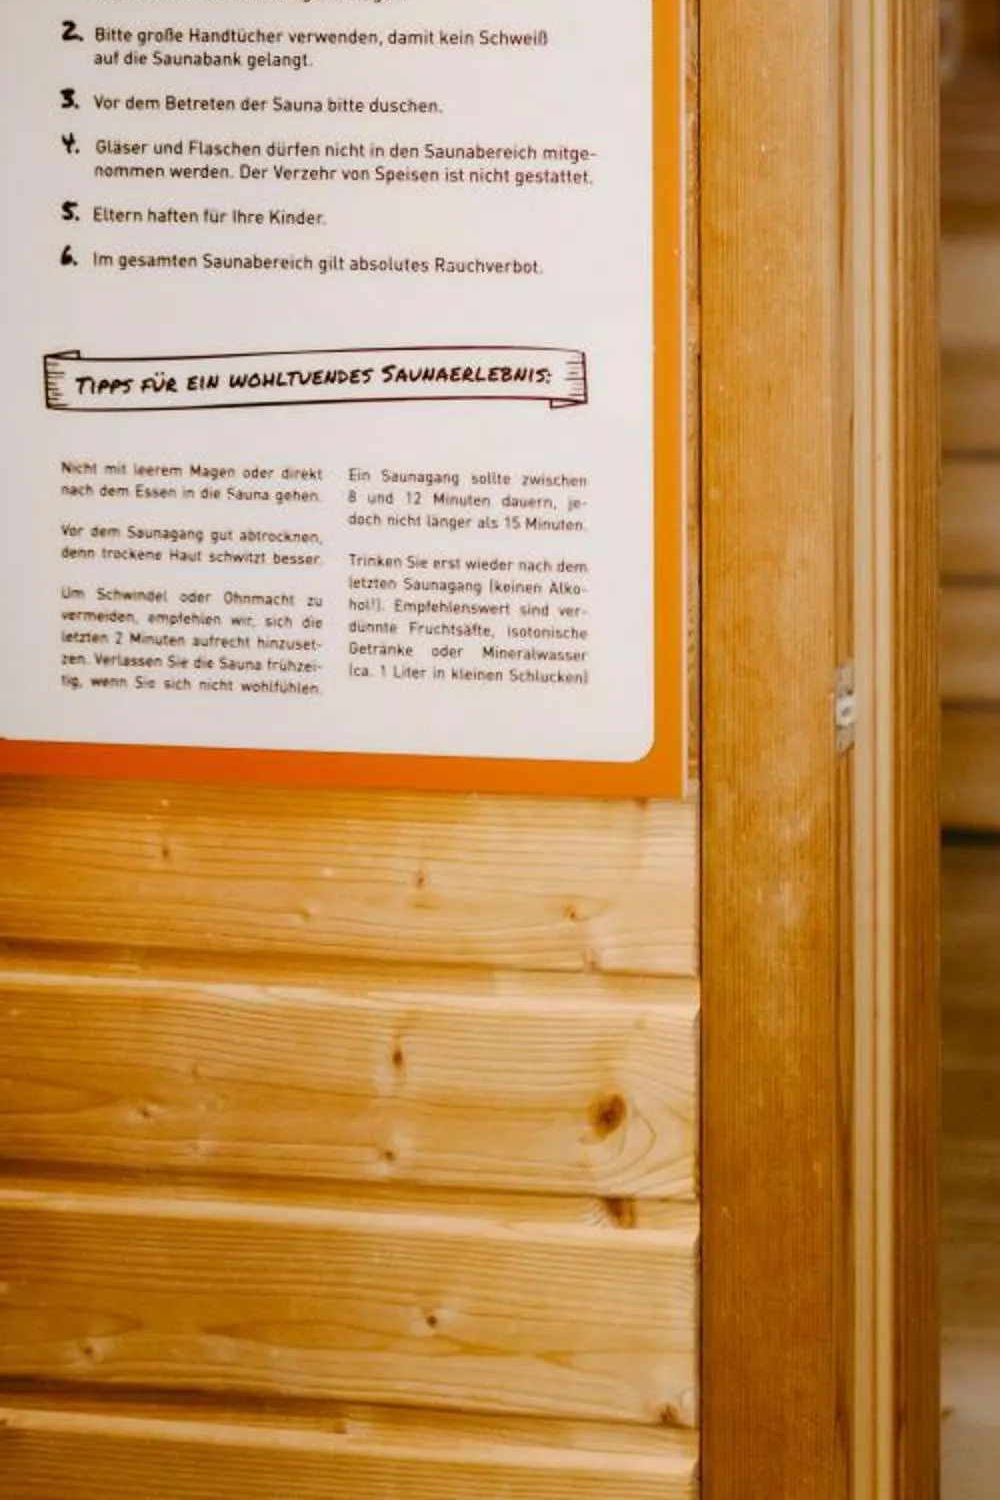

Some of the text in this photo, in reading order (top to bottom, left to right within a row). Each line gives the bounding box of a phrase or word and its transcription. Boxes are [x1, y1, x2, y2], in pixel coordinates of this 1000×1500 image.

[62, 19, 84, 41] 2.
[95, 27, 133, 43] Bitte
[137, 28, 183, 46] große
[189, 28, 283, 44] Handtücher
[288, 29, 382, 46] verwenden,
[388, 30, 434, 45] damit
[440, 30, 474, 45] kein
[94, 50, 312, 71] auf die Saunabank gelangt.
[60, 88, 442, 113] 3. Vor dem Betreten der Sauna bitte duschen.
[61, 132, 596, 166] 4. Gläser und Flaschen dürfen nicht in den Saunabereich mitge-
[94, 164, 592, 187] nommen werden. Der Verzehr von Speisen ist nicht gestattet.
[62, 201, 325, 225] 5. Eltern haften für Ihre Kinder.
[60, 245, 542, 274] 6. Im gesamten Saunabereich gilt absolutes Rauchverbot.
[61, 461, 322, 481] Nicht mit leerem Magen oder direkt
[348, 468, 589, 487] Ein Saunagang sollte zwischen
[61, 484, 94, 496] nach
[99, 484, 130, 497] dem
[135, 484, 176, 499] Essen
[183, 487, 195, 498] in
[200, 487, 221, 499] die
[227, 487, 270, 500] Sauna
[347, 489, 556, 510] 8 und 12 Minuten dauern,
[347, 512, 382, 526] doch
[387, 514, 421, 527] nicht
[477, 516, 499, 529] als
[505, 516, 521, 530] 15
[61, 524, 84, 537] Vor
[90, 526, 120, 538] dem
[127, 525, 204, 544] Saunagang
[210, 531, 233, 544] gut
[61, 546, 95, 559] denn
[169, 549, 201, 562] Haut
[209, 551, 266, 564] schwitzt
[348, 553, 588, 573] Trinken Sie erst wieder nach dem
[348, 576, 482, 596] letzten Saunagang
[61, 587, 323, 607] Um Schwindel oder Ohnmacht zu
[394, 598, 549, 617] Empfehlenswert sind
[265, 615, 292, 628] sich
[302, 616, 323, 628] die
[129, 632, 185, 647] Minuten
[94, 653, 262, 671] Verlassen Sie die Sauna
[432, 644, 463, 658] oder
[482, 646, 588, 662] Mineralwasser
[393, 665, 426, 679] Liter
[433, 665, 445, 679] in
[451, 667, 503, 681] kleinen
[90, 676, 233, 691] wenn Sie sich nicht
